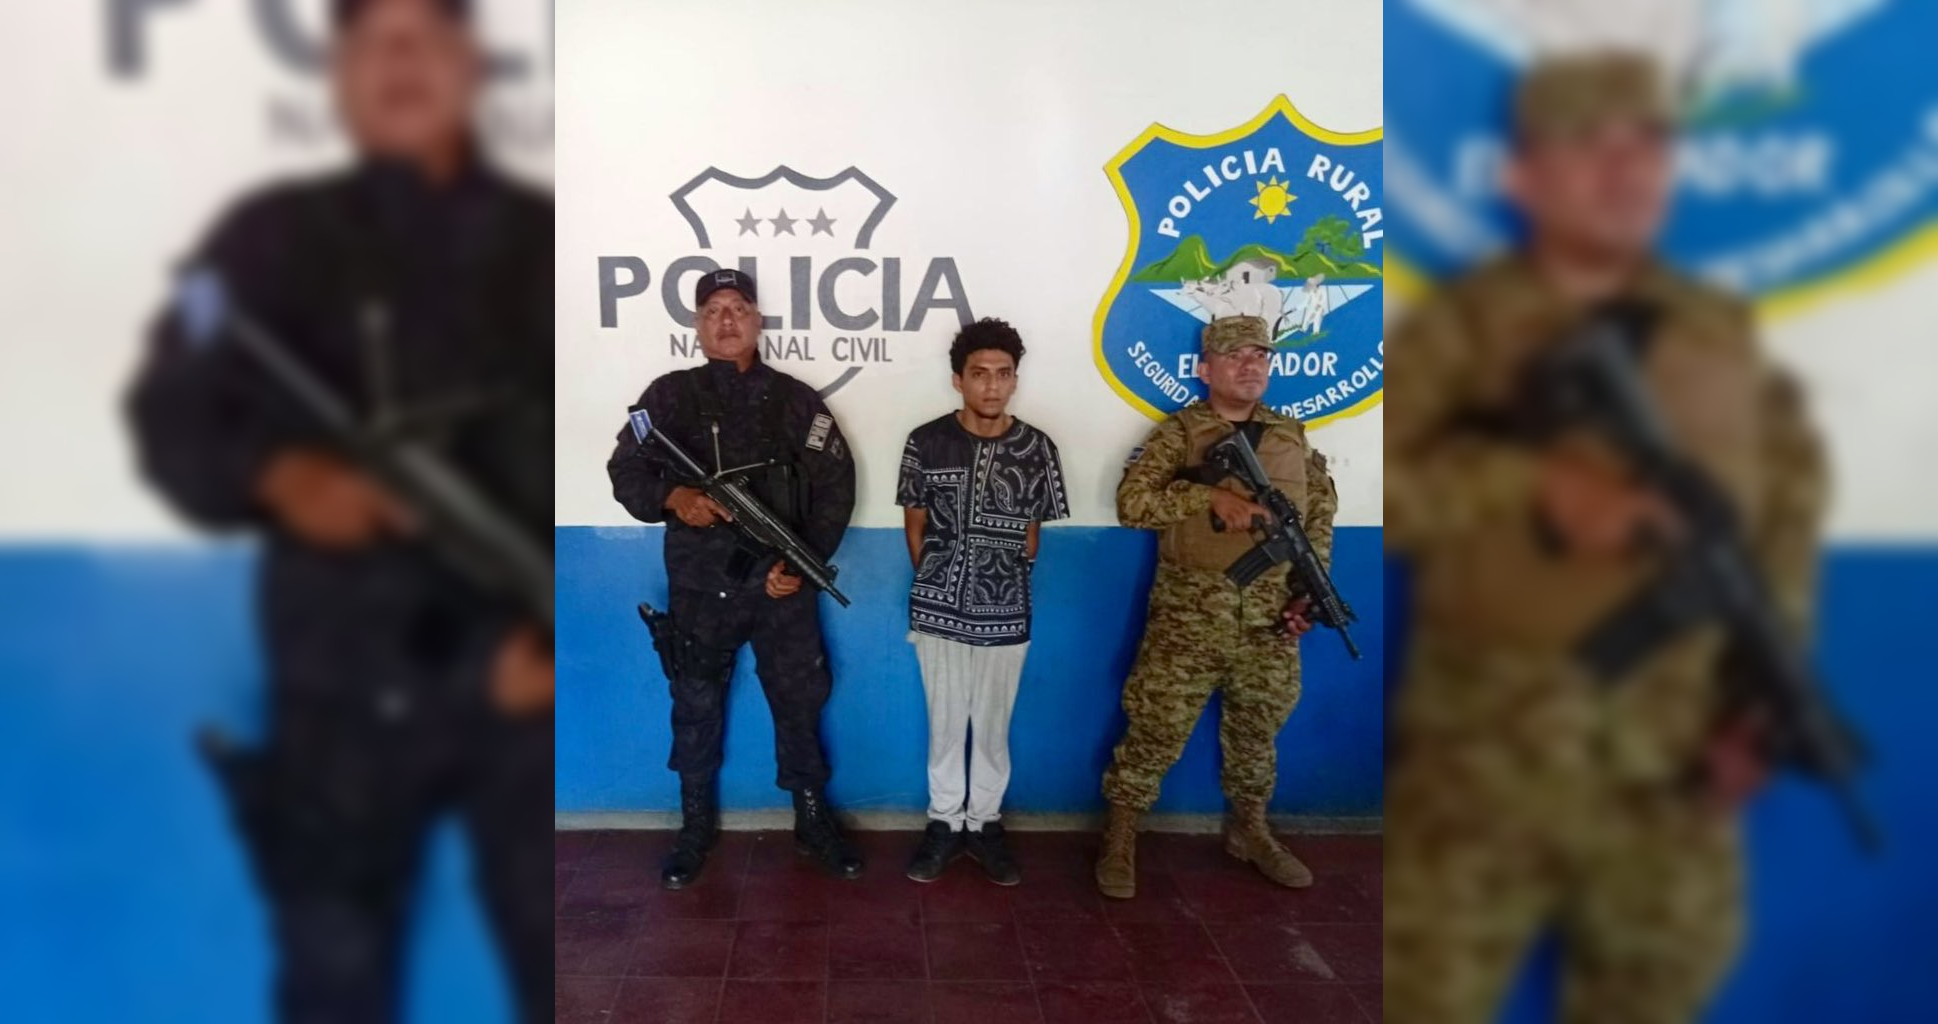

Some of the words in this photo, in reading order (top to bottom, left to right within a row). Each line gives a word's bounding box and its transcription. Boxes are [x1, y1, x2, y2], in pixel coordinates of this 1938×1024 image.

[1157, 148, 1285, 238] POLICIA
[1307, 154, 1383, 249] RURAL
[669, 334, 815, 361] NANAL
[832, 336, 893, 362] CIVIL
[1127, 341, 1200, 407] SEGURIDA
